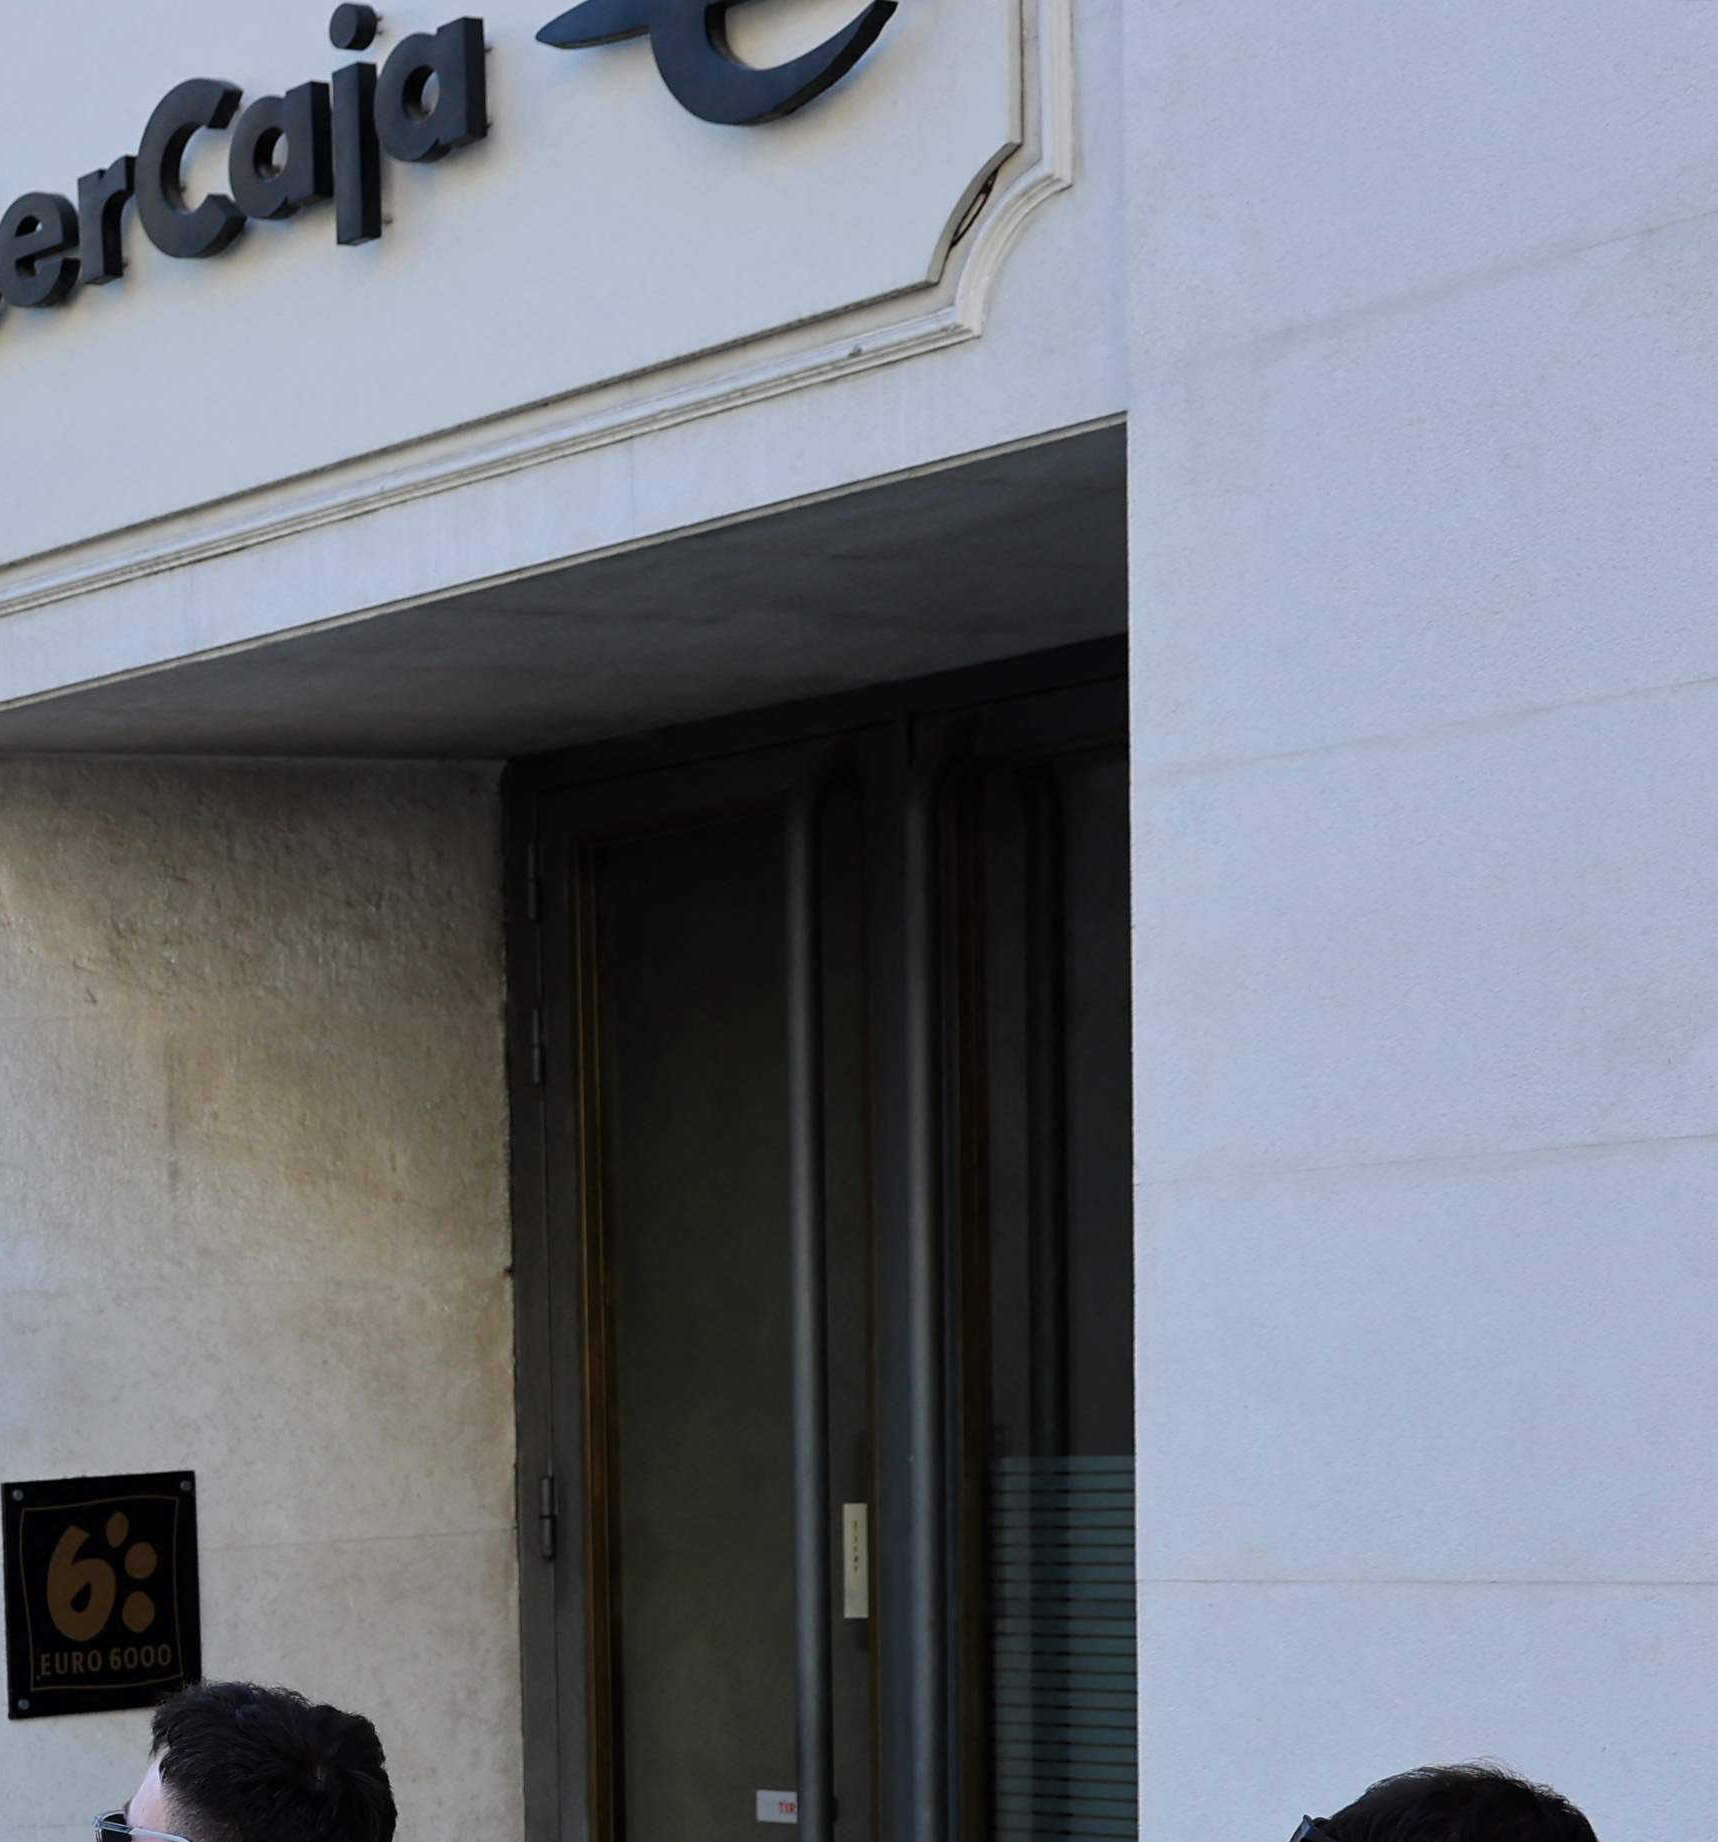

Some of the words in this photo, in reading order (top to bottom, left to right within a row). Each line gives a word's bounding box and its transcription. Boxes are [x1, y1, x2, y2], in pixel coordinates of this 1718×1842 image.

[40, 1650, 102, 1676] EURO
[109, 1644, 172, 1671] 6000
[778, 1801, 798, 1816] TIR
